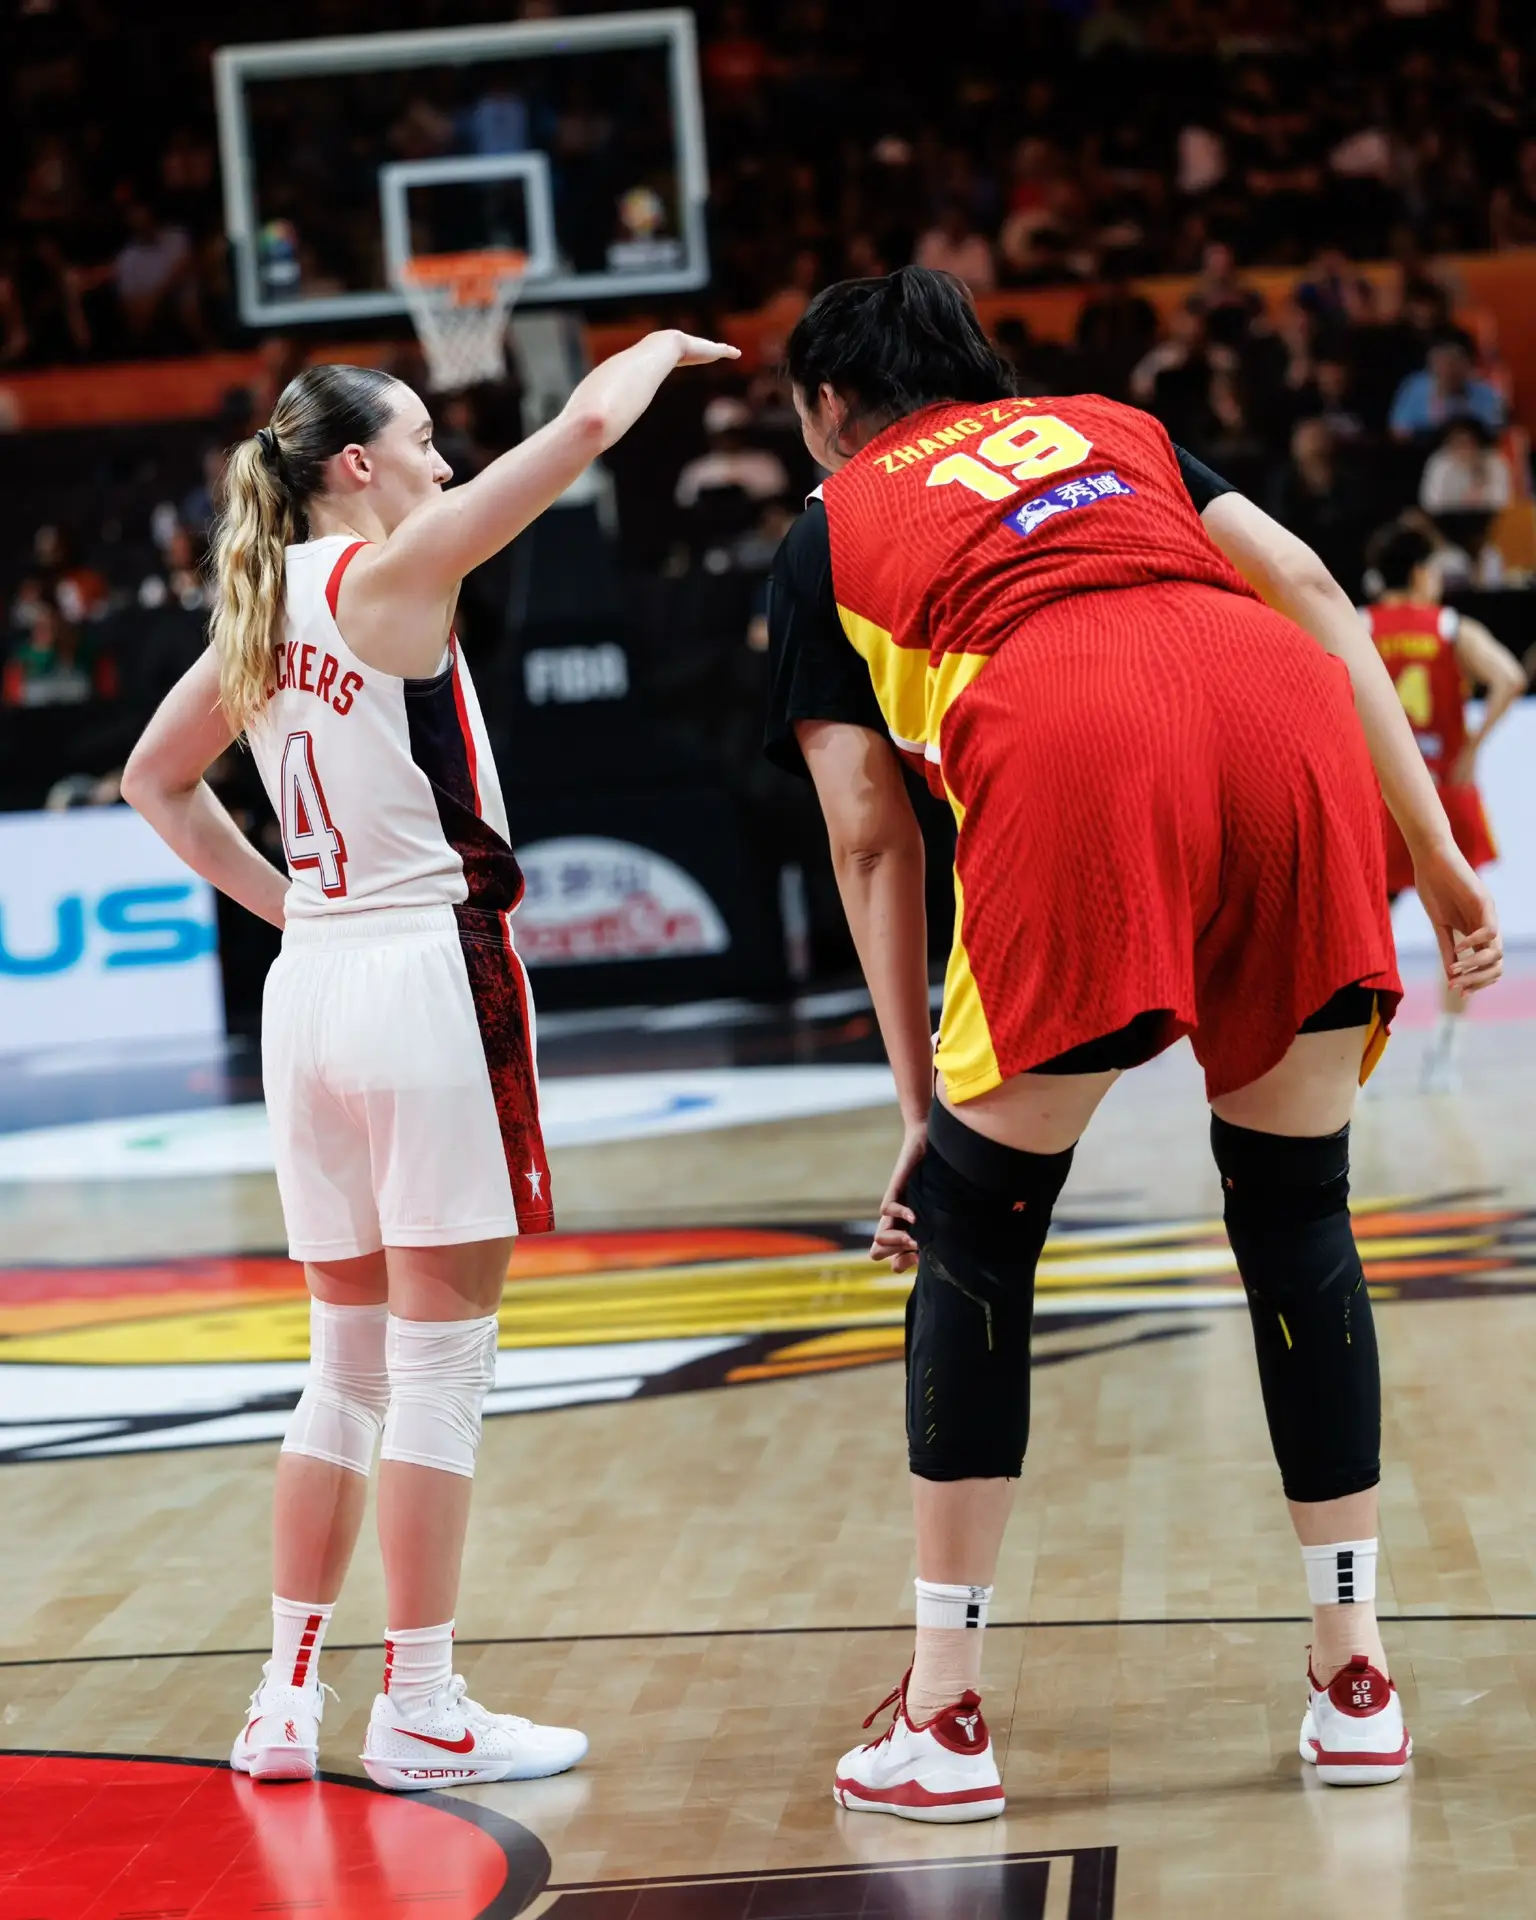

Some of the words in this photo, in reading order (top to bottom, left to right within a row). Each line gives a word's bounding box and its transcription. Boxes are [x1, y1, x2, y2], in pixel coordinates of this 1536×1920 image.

[873, 418, 984, 474] ZHANG
[926, 415, 1094, 502] 19
[266, 640, 365, 717] CKERS
[524, 644, 628, 704] FIBA
[1397, 664, 1430, 728] 4
[281, 730, 349, 899] 4
